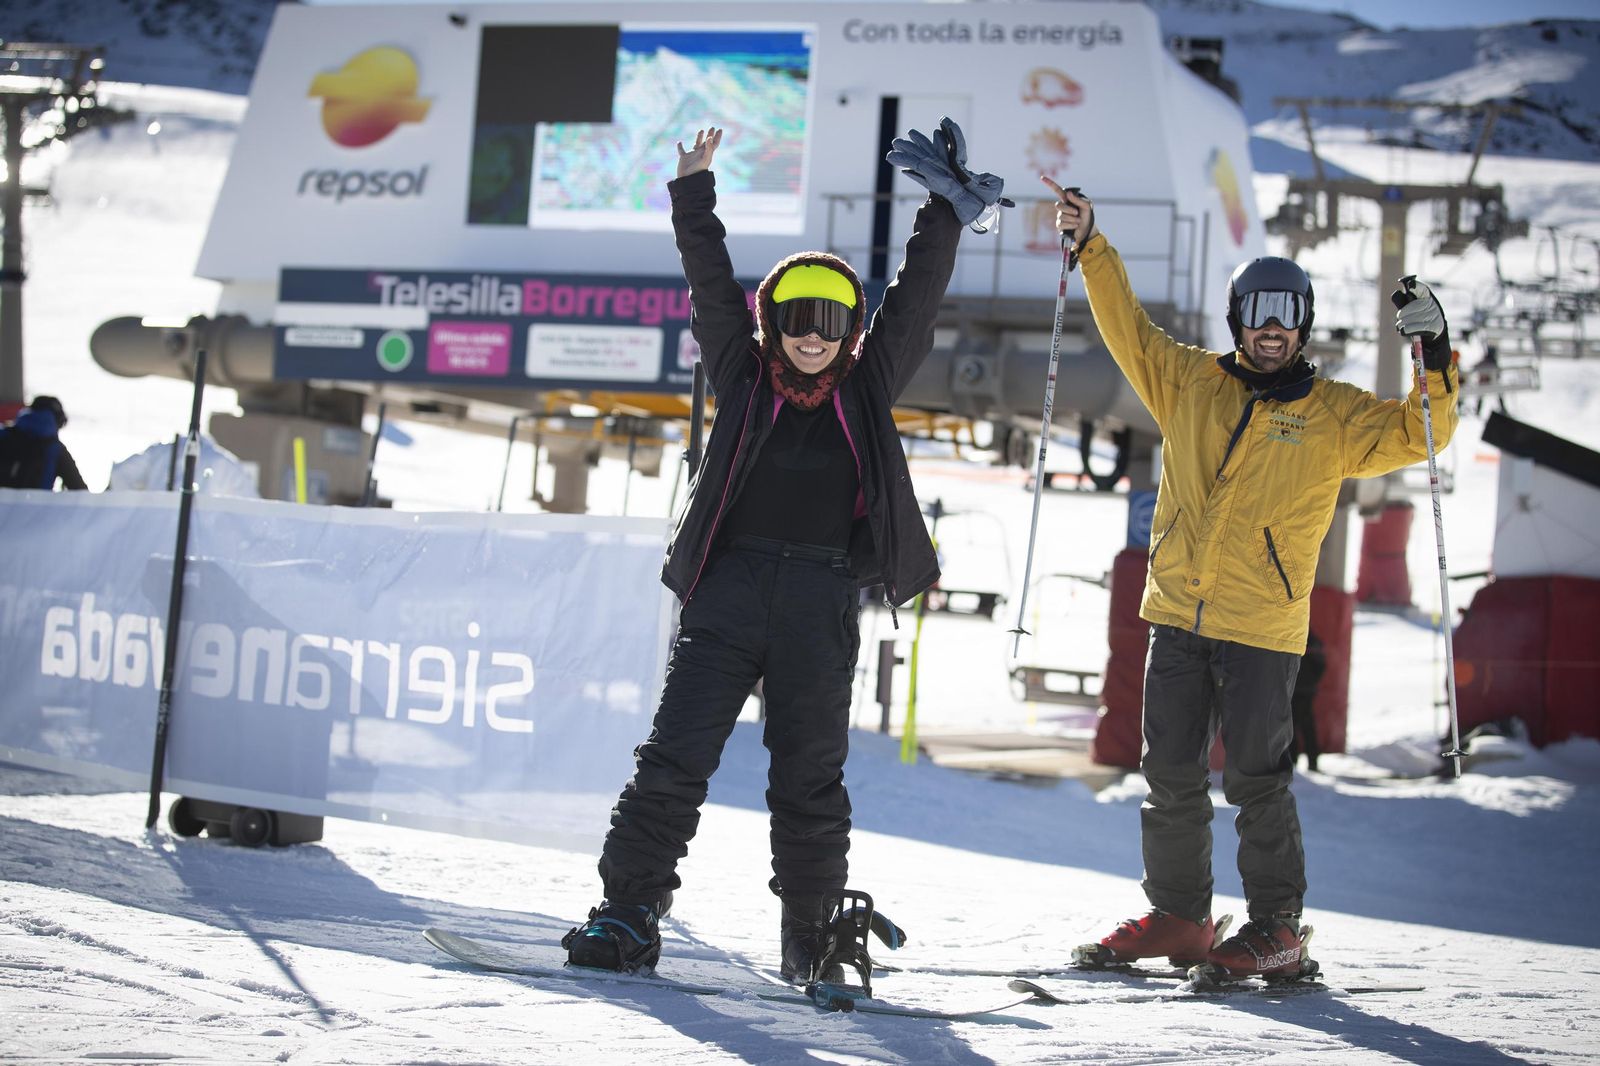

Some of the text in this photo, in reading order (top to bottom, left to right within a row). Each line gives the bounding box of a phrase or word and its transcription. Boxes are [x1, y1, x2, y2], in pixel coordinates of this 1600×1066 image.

[842, 18, 1123, 49] Con toda la energía
[297, 163, 430, 203] repsol
[1269, 419, 1305, 431] COMPANY
[1271, 409, 1307, 421] FINLAND
[1256, 947, 1300, 971] LANGE
